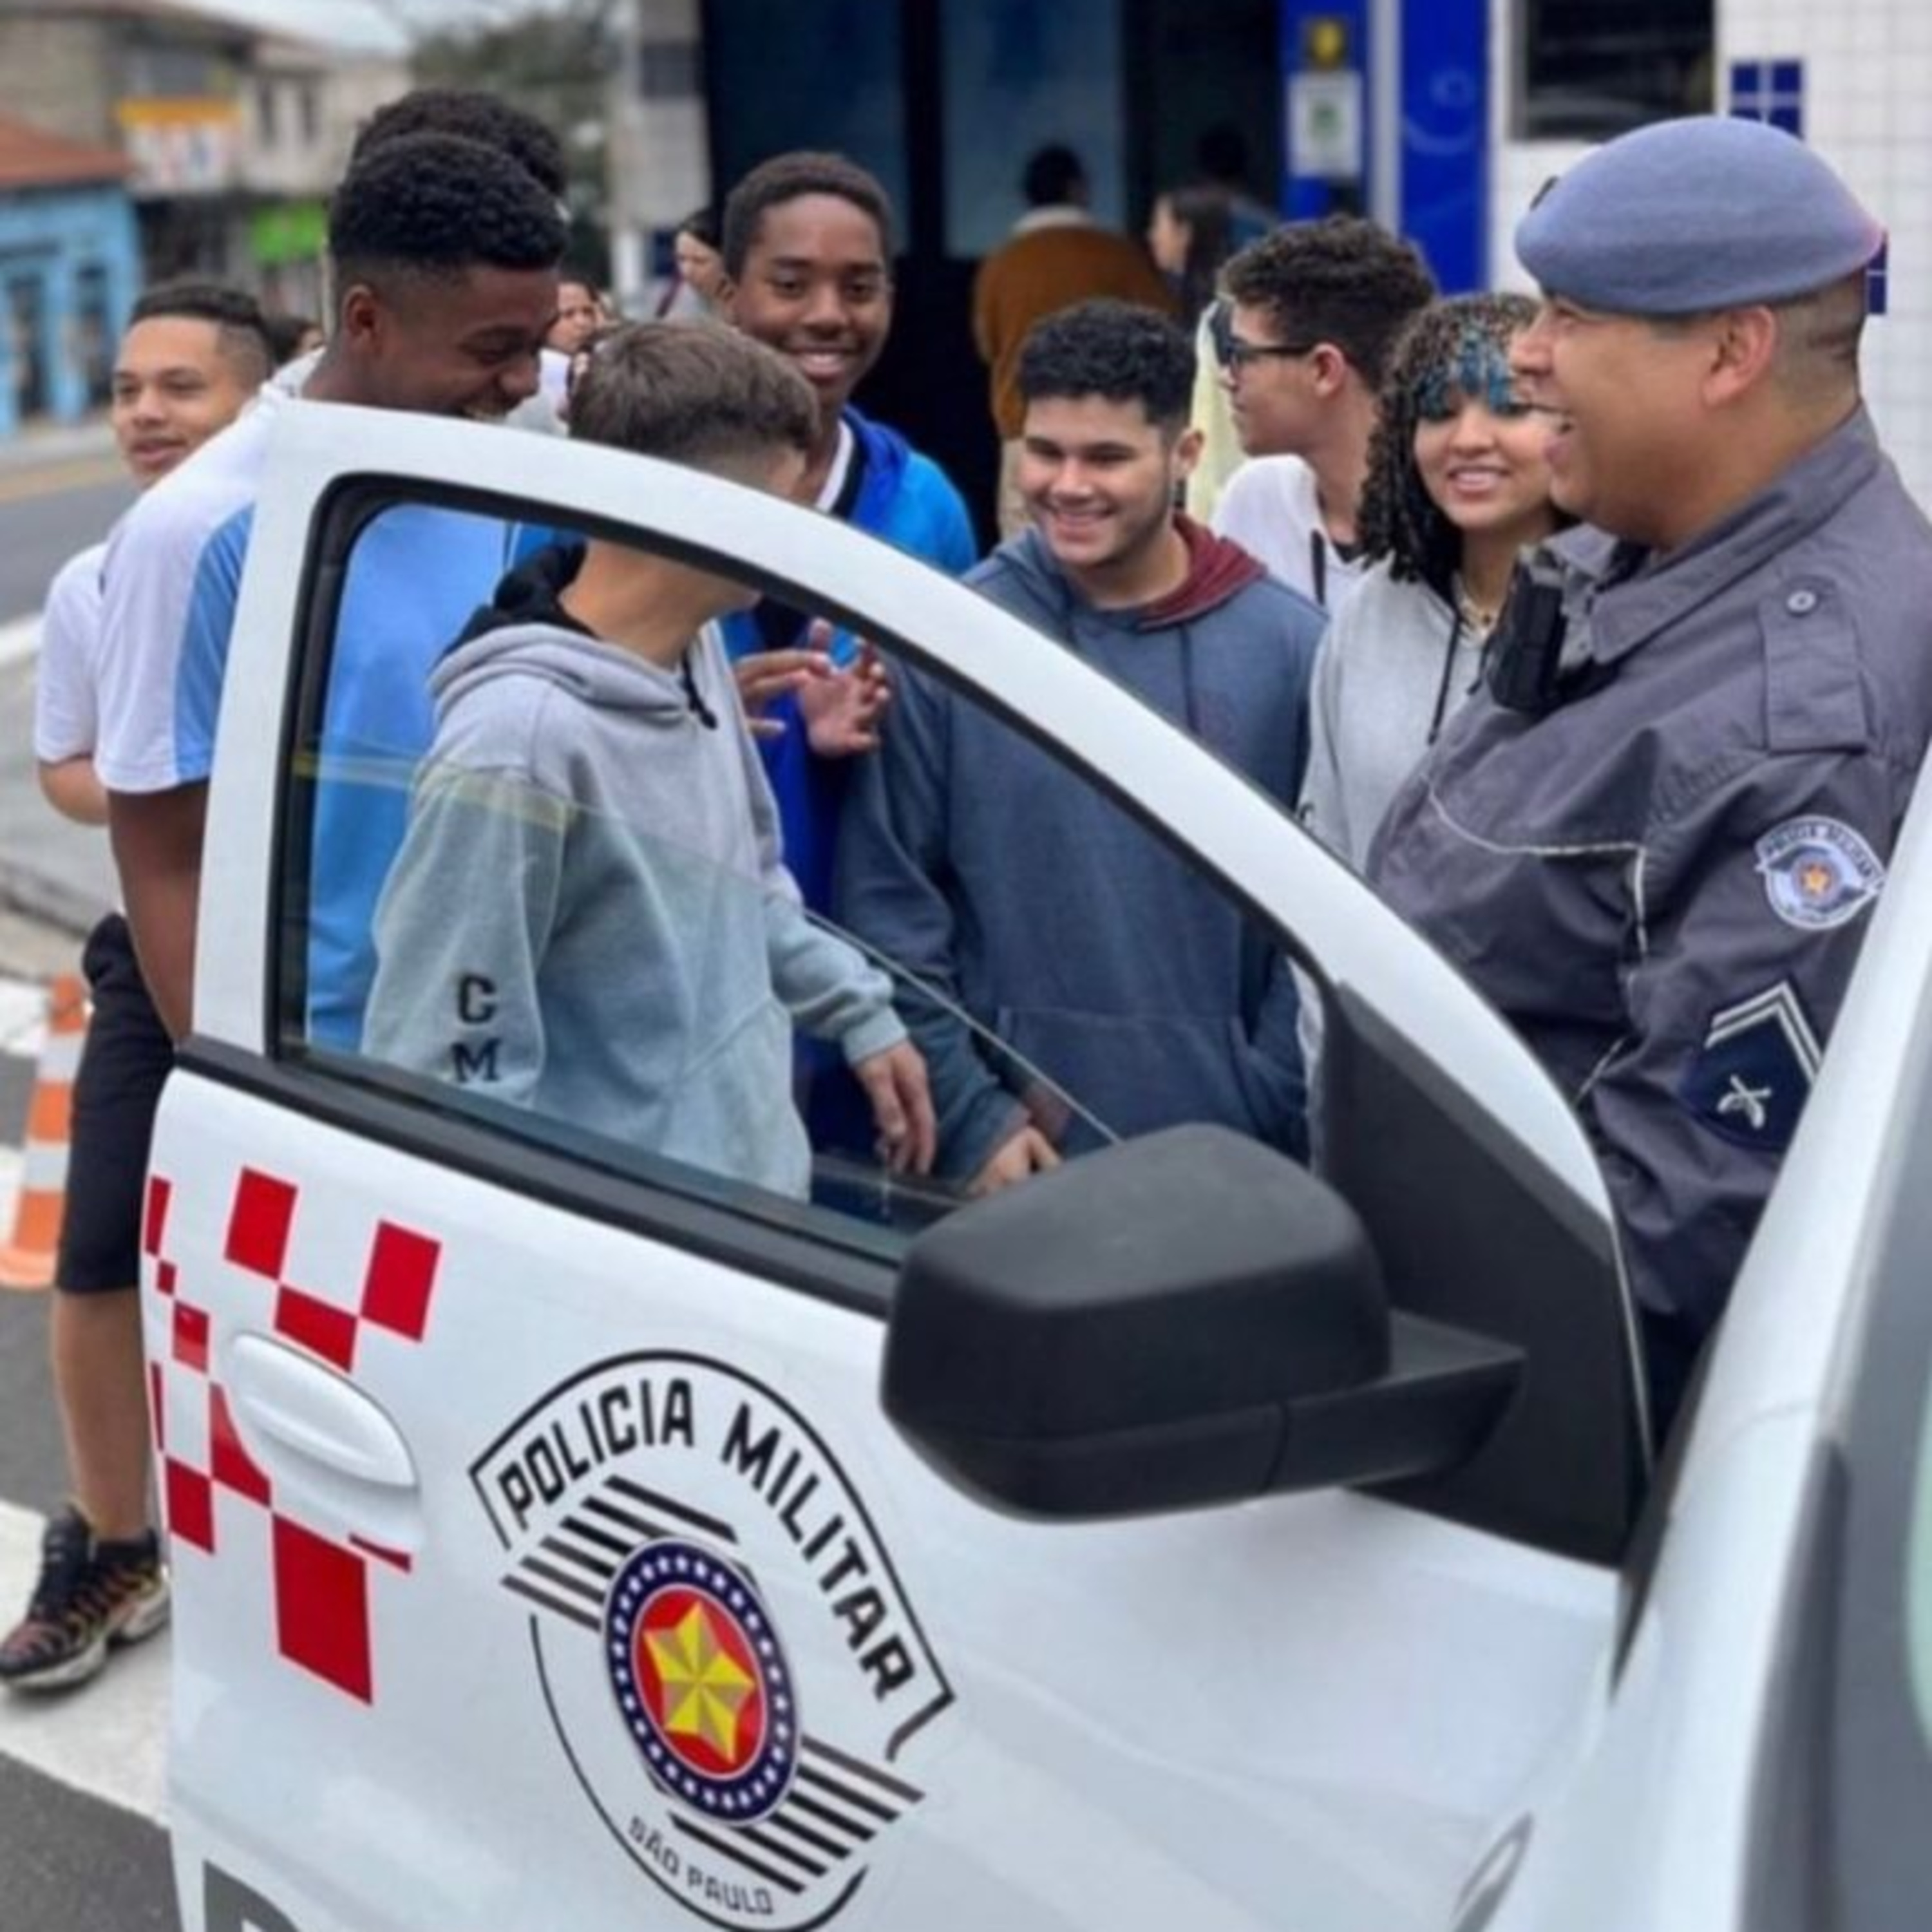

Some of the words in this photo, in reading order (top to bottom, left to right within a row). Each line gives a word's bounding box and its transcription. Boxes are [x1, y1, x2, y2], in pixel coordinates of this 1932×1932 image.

[497, 1378, 695, 1530] POLICIA
[721, 1401, 915, 1701] MILITAR
[688, 1866, 773, 1915] PAULO
